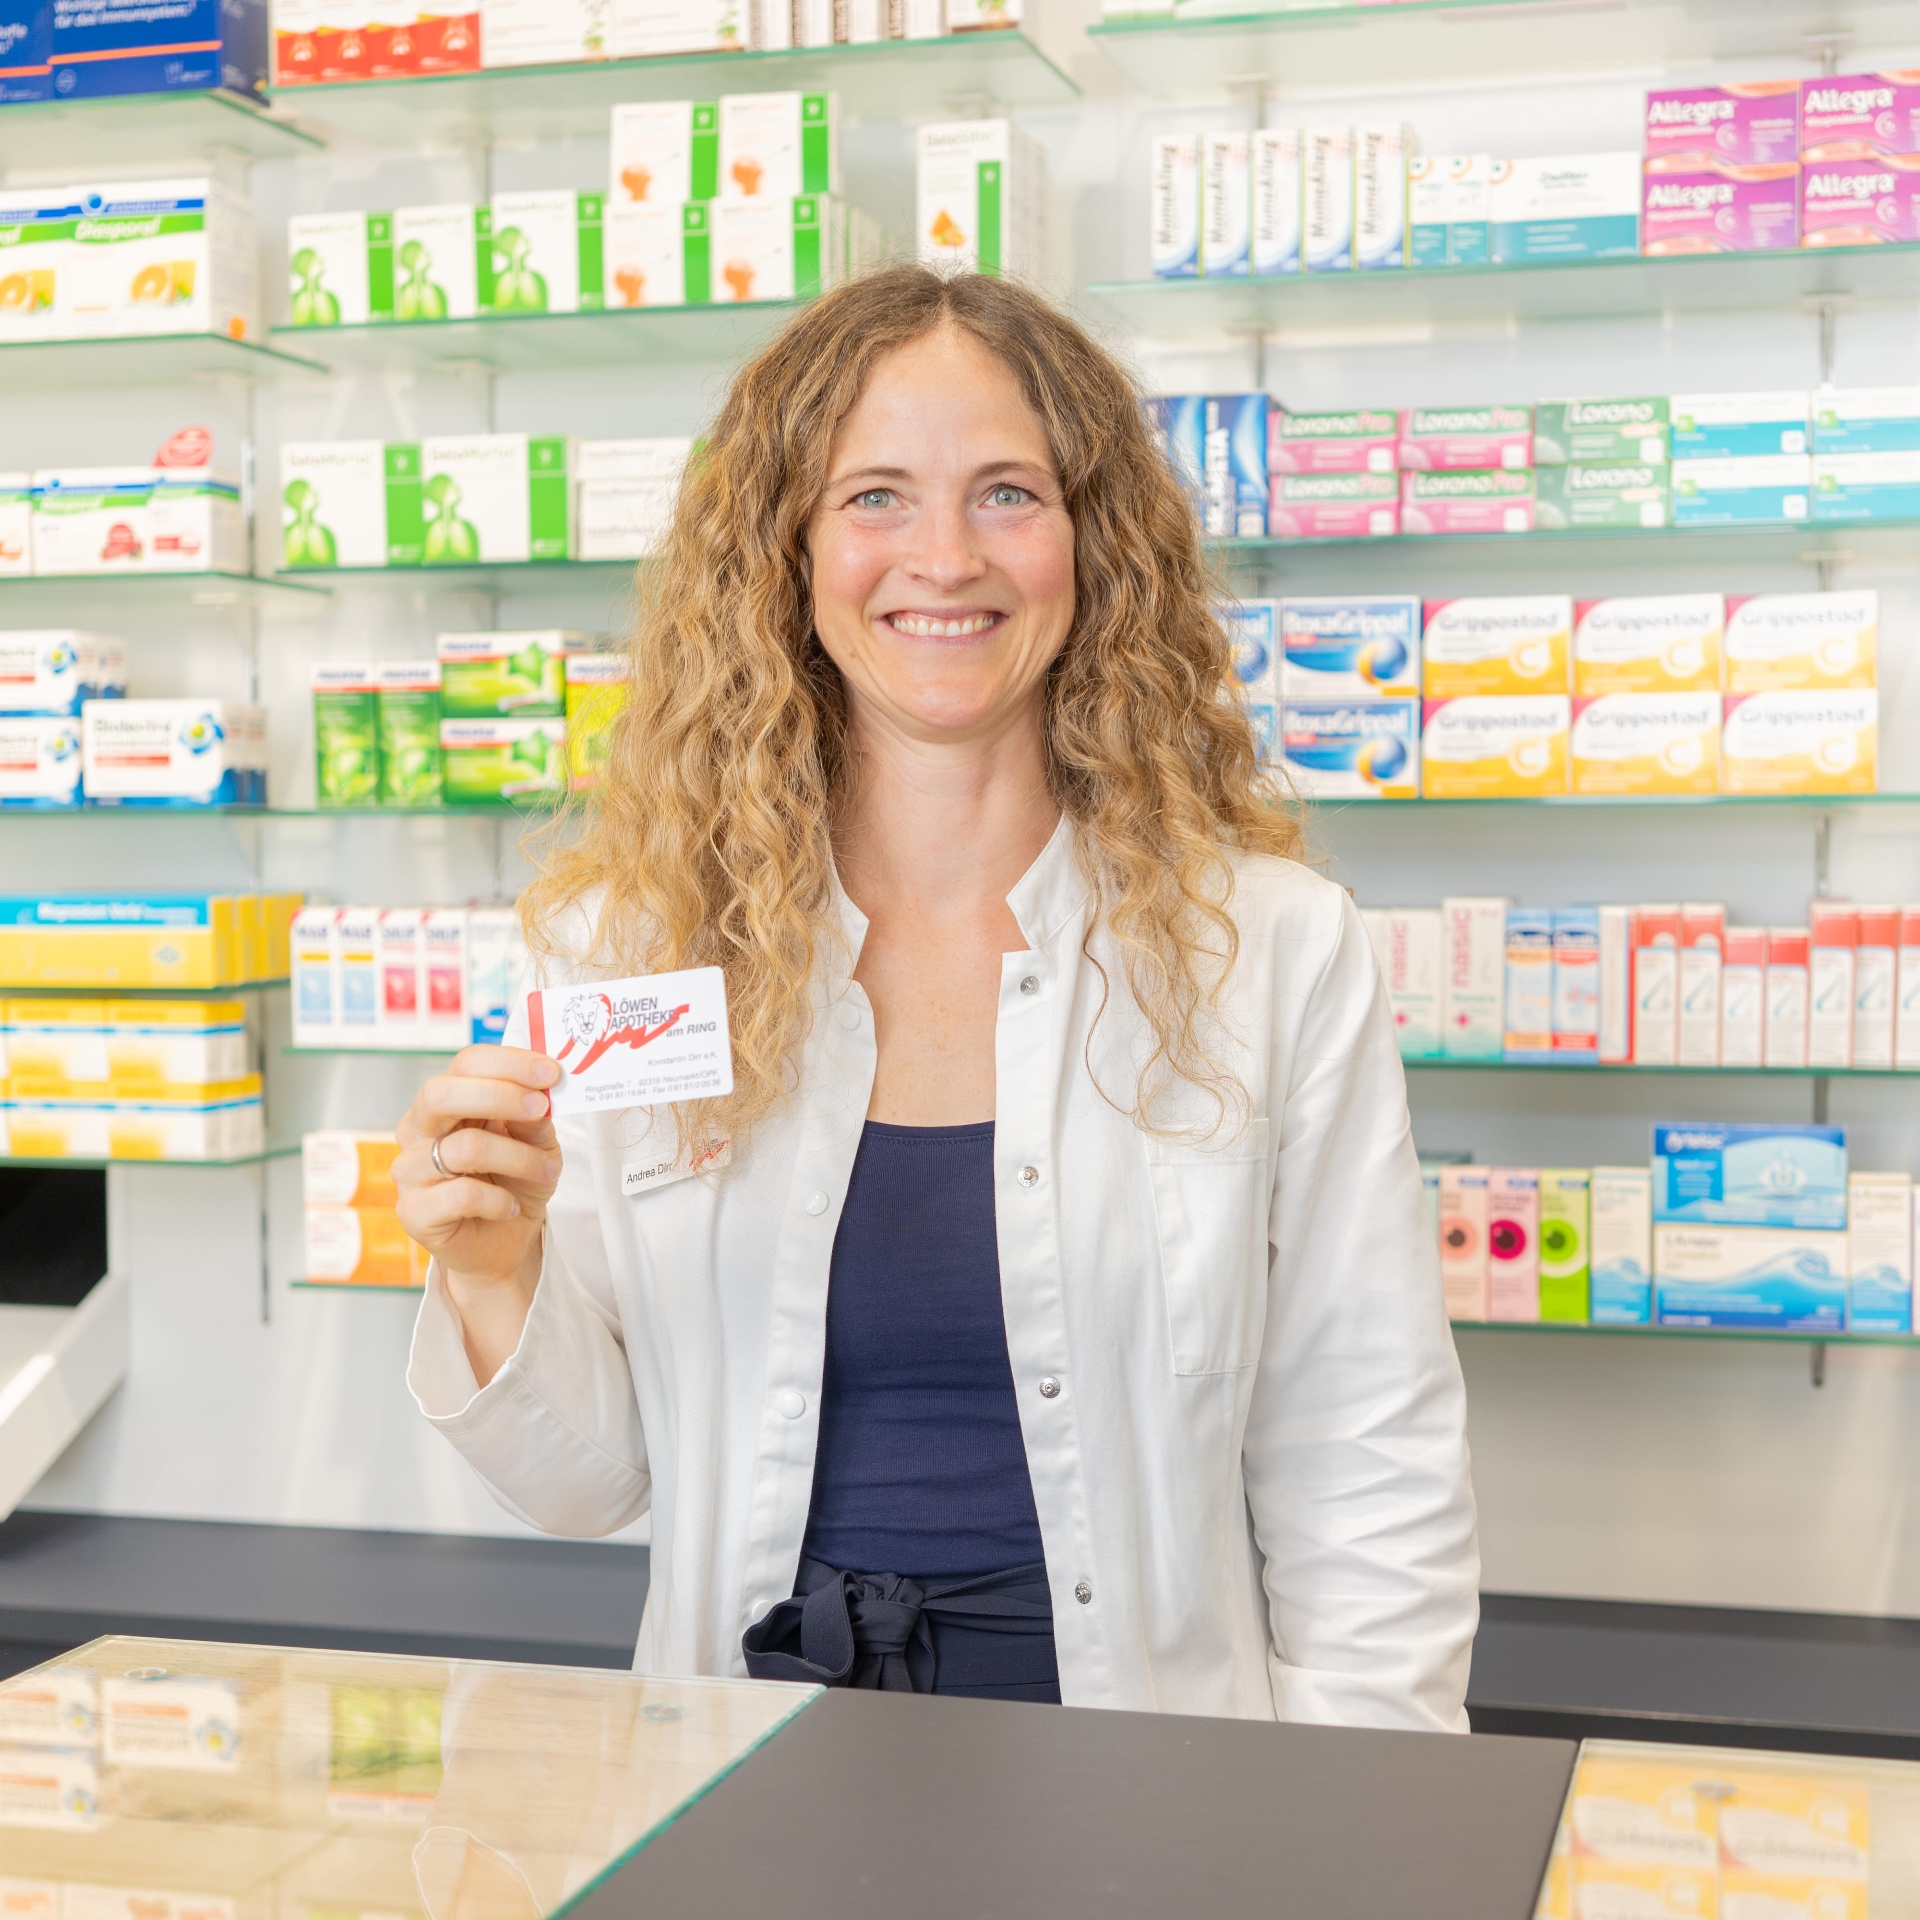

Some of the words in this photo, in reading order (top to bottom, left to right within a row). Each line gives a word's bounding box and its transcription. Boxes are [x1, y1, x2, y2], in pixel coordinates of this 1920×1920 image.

[1804, 88, 1895, 113] Allegra
[1649, 100, 1736, 125] Allegra
[1648, 183, 1735, 209] Allegra
[1805, 173, 1896, 199] Allegra
[1572, 402, 1655, 424] Lorano
[1572, 466, 1655, 489] Lorano
[1438, 612, 1560, 633] Grippostad
[1590, 611, 1711, 632] Grippostad
[1741, 608, 1866, 630] Grippostad
[1438, 711, 1560, 733] Grippostad
[1586, 708, 1710, 730] Grippostad
[1740, 705, 1867, 727] Grippostad
[1451, 906, 1471, 988] nasic
[613, 997, 658, 1015] LÖWEN
[610, 1009, 679, 1031] APOTHEKE
[666, 1027, 684, 1037] am
[687, 1021, 717, 1035] RING
[647, 1055, 687, 1067] Konstantin
[688, 1053, 702, 1062] Dirr
[585, 1082, 625, 1094] Ringstraße
[638, 1077, 661, 1087] 92318
[652, 1086, 666, 1095] Fax
[626, 1169, 656, 1185] Andrea
